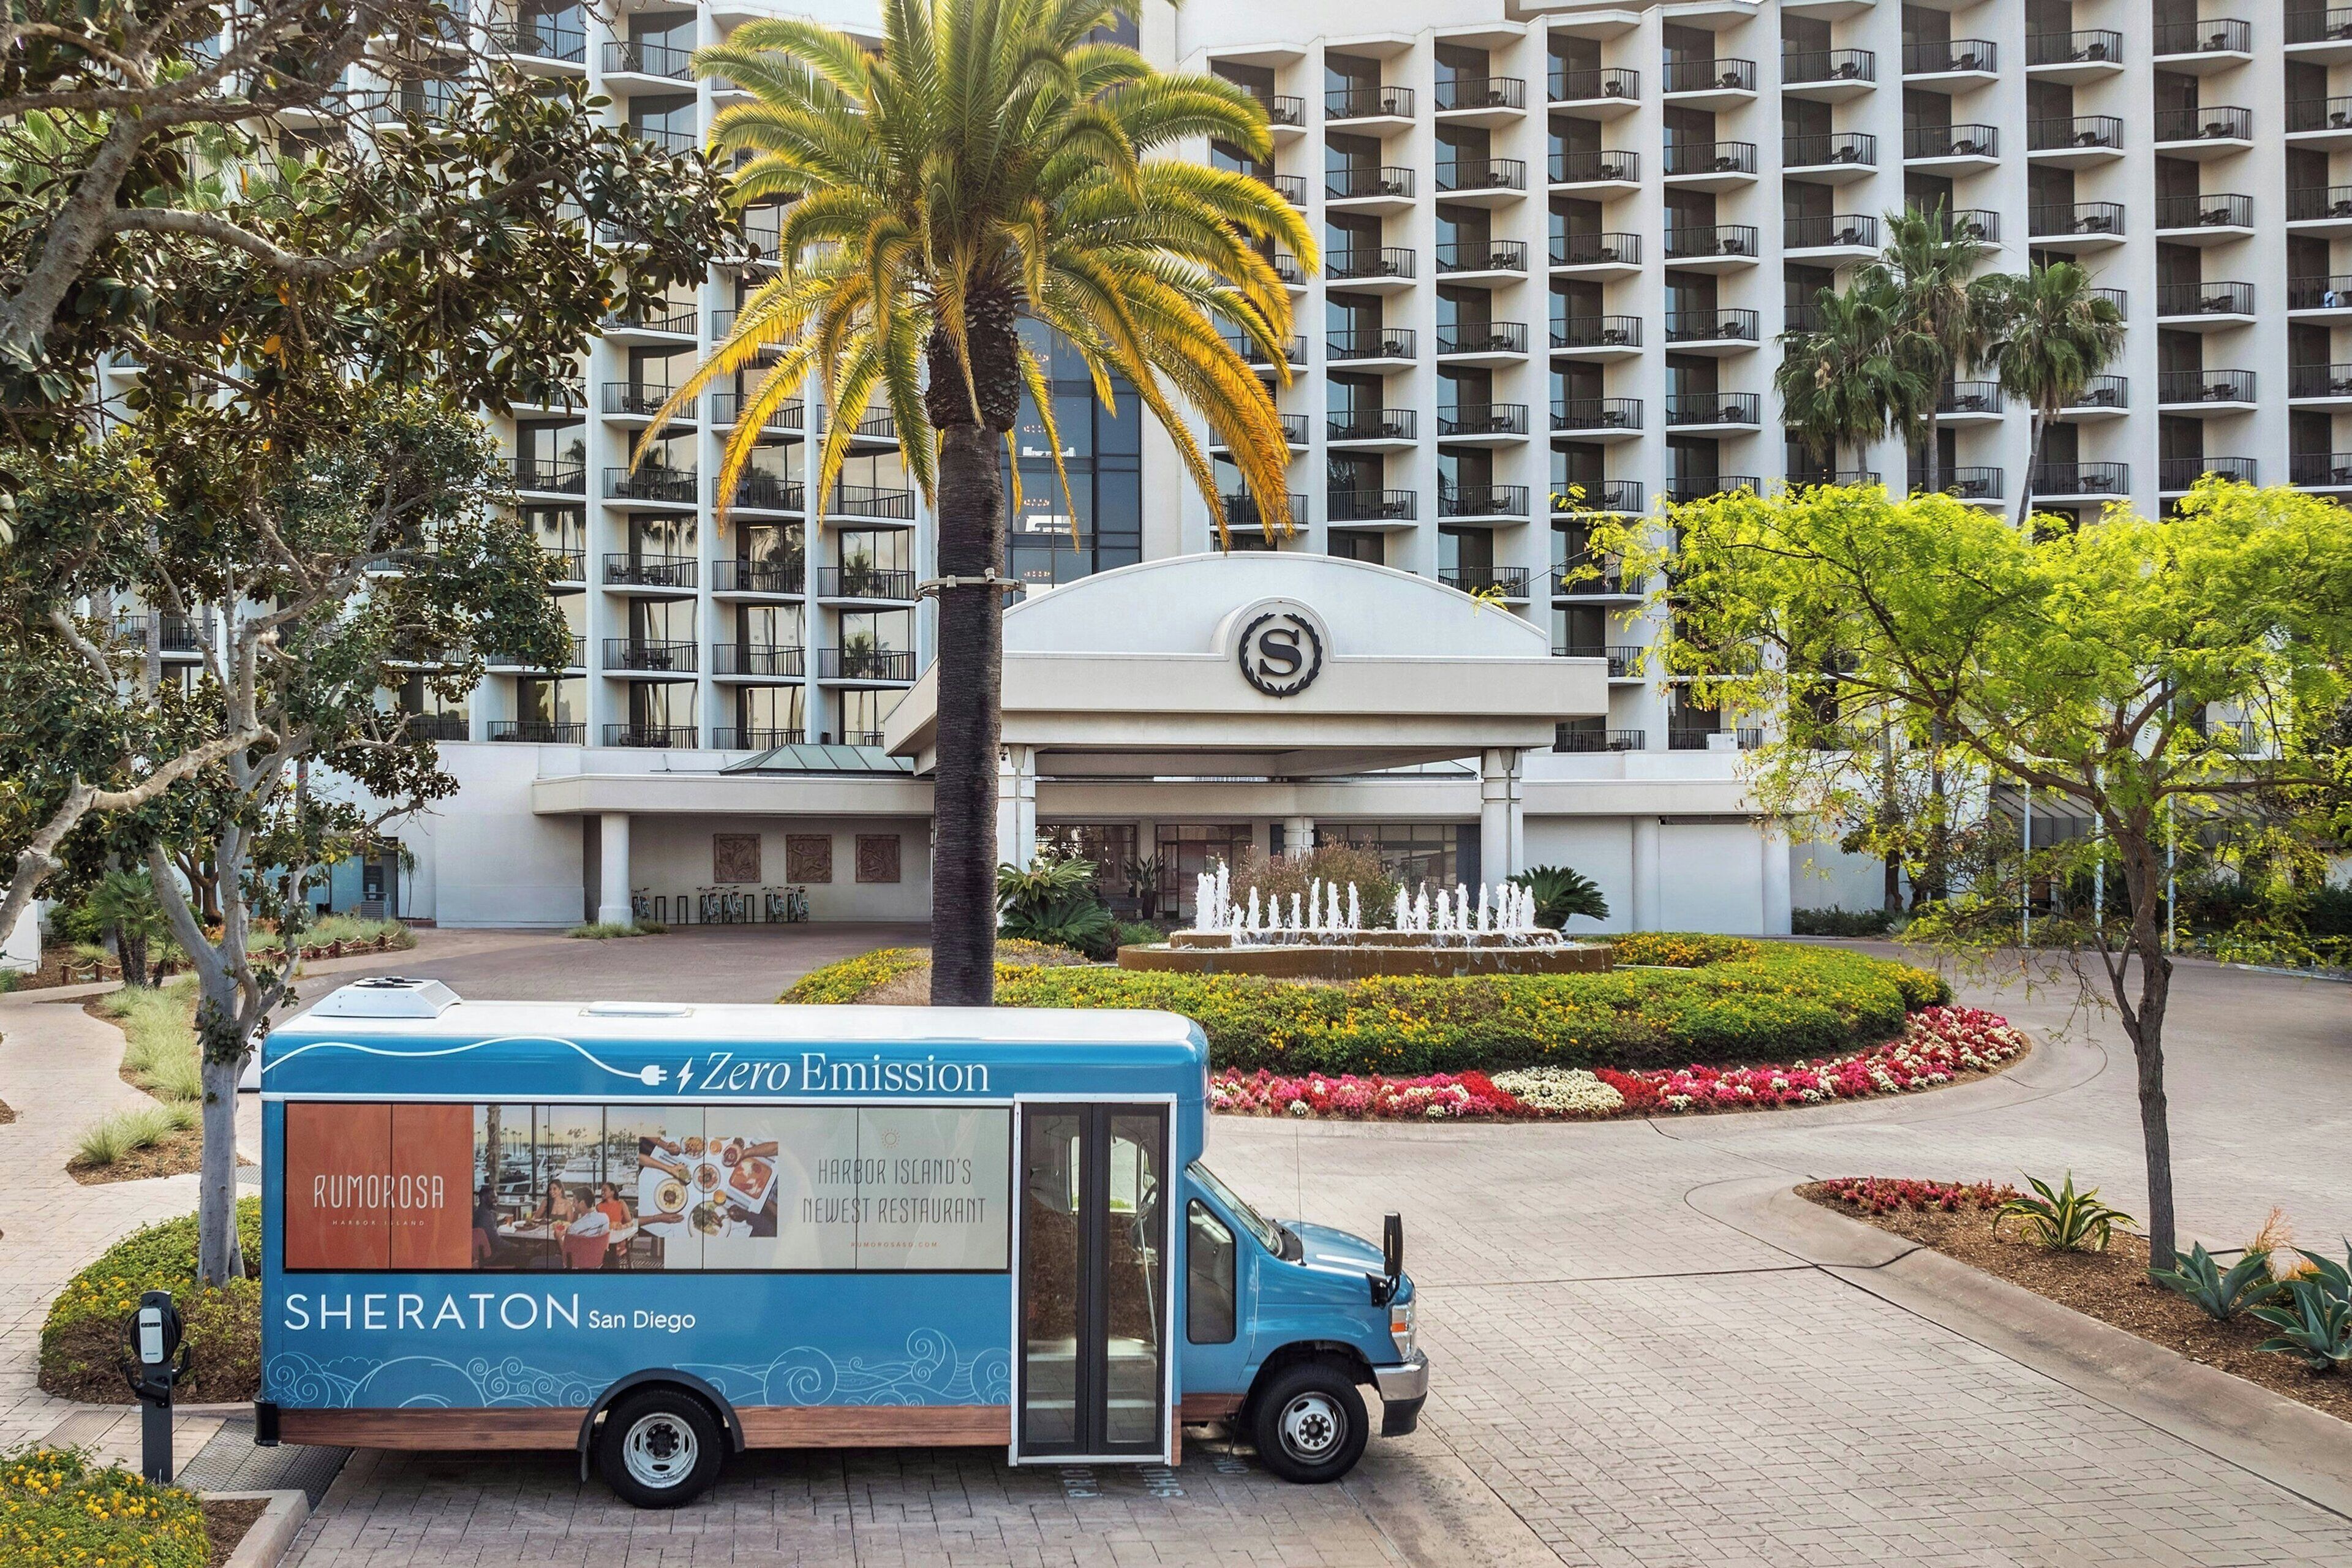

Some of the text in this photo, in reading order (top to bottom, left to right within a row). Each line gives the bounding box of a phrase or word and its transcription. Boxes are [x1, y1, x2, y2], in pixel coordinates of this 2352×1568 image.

[1259, 628, 1302, 676] S
[699, 1052, 991, 1092] Zero Emission
[818, 1158, 971, 1185] HARBOR ISLAND'S
[314, 1175, 443, 1208] RUMOROSA
[802, 1197, 987, 1224] NEWEST RESTAURANT
[284, 1293, 696, 1333] SHERATON San Diego
